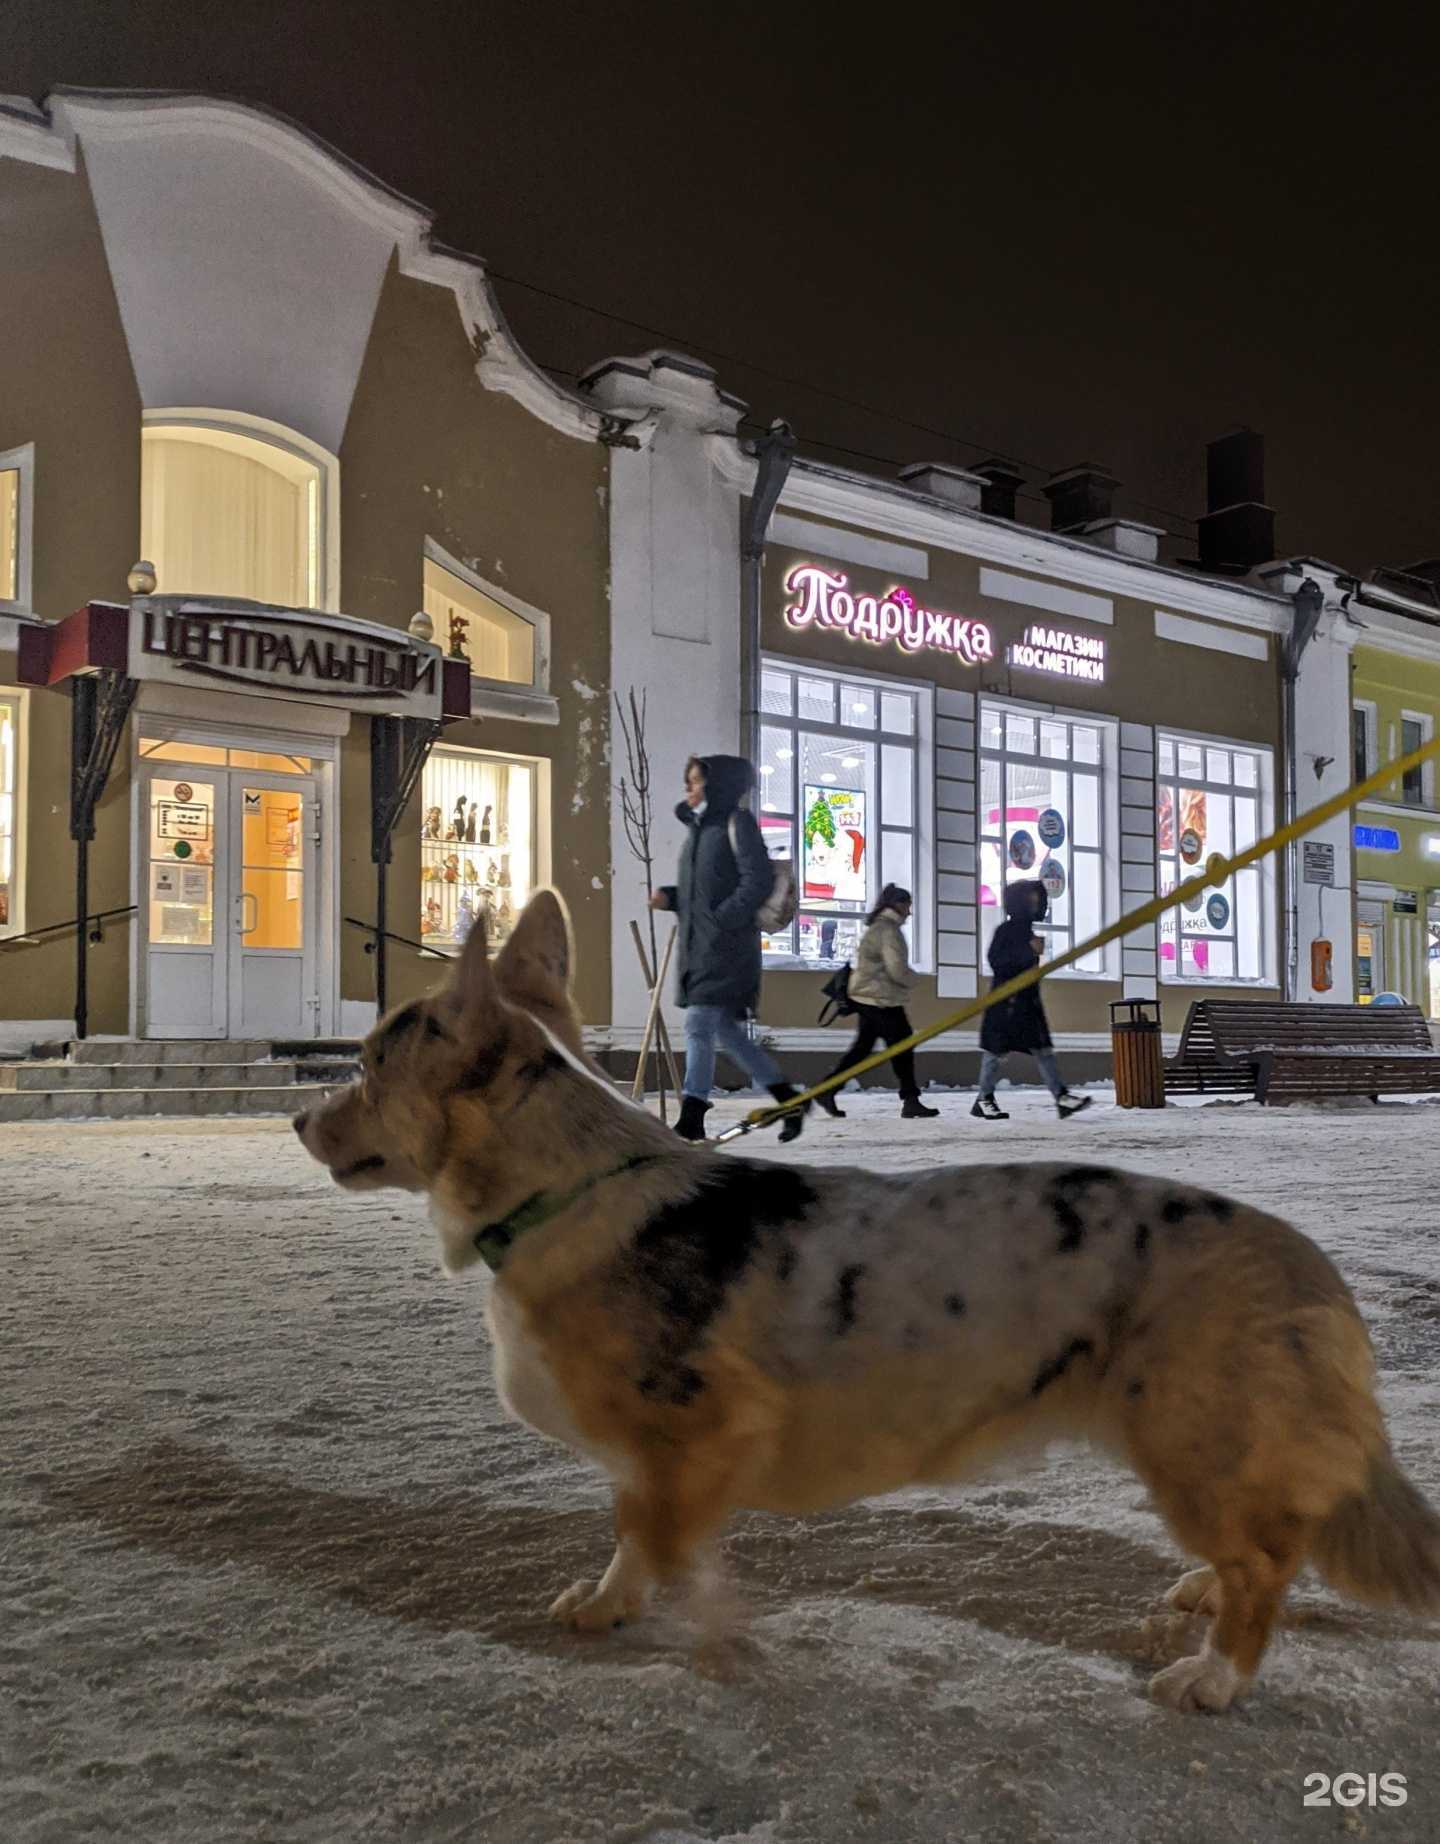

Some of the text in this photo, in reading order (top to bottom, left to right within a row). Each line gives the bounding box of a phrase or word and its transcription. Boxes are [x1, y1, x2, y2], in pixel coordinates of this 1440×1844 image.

[786, 565, 994, 665] Подружка
[1030, 625, 1104, 660] МАГАЗИН
[1012, 643, 1104, 681] КОСМЕТИКИ
